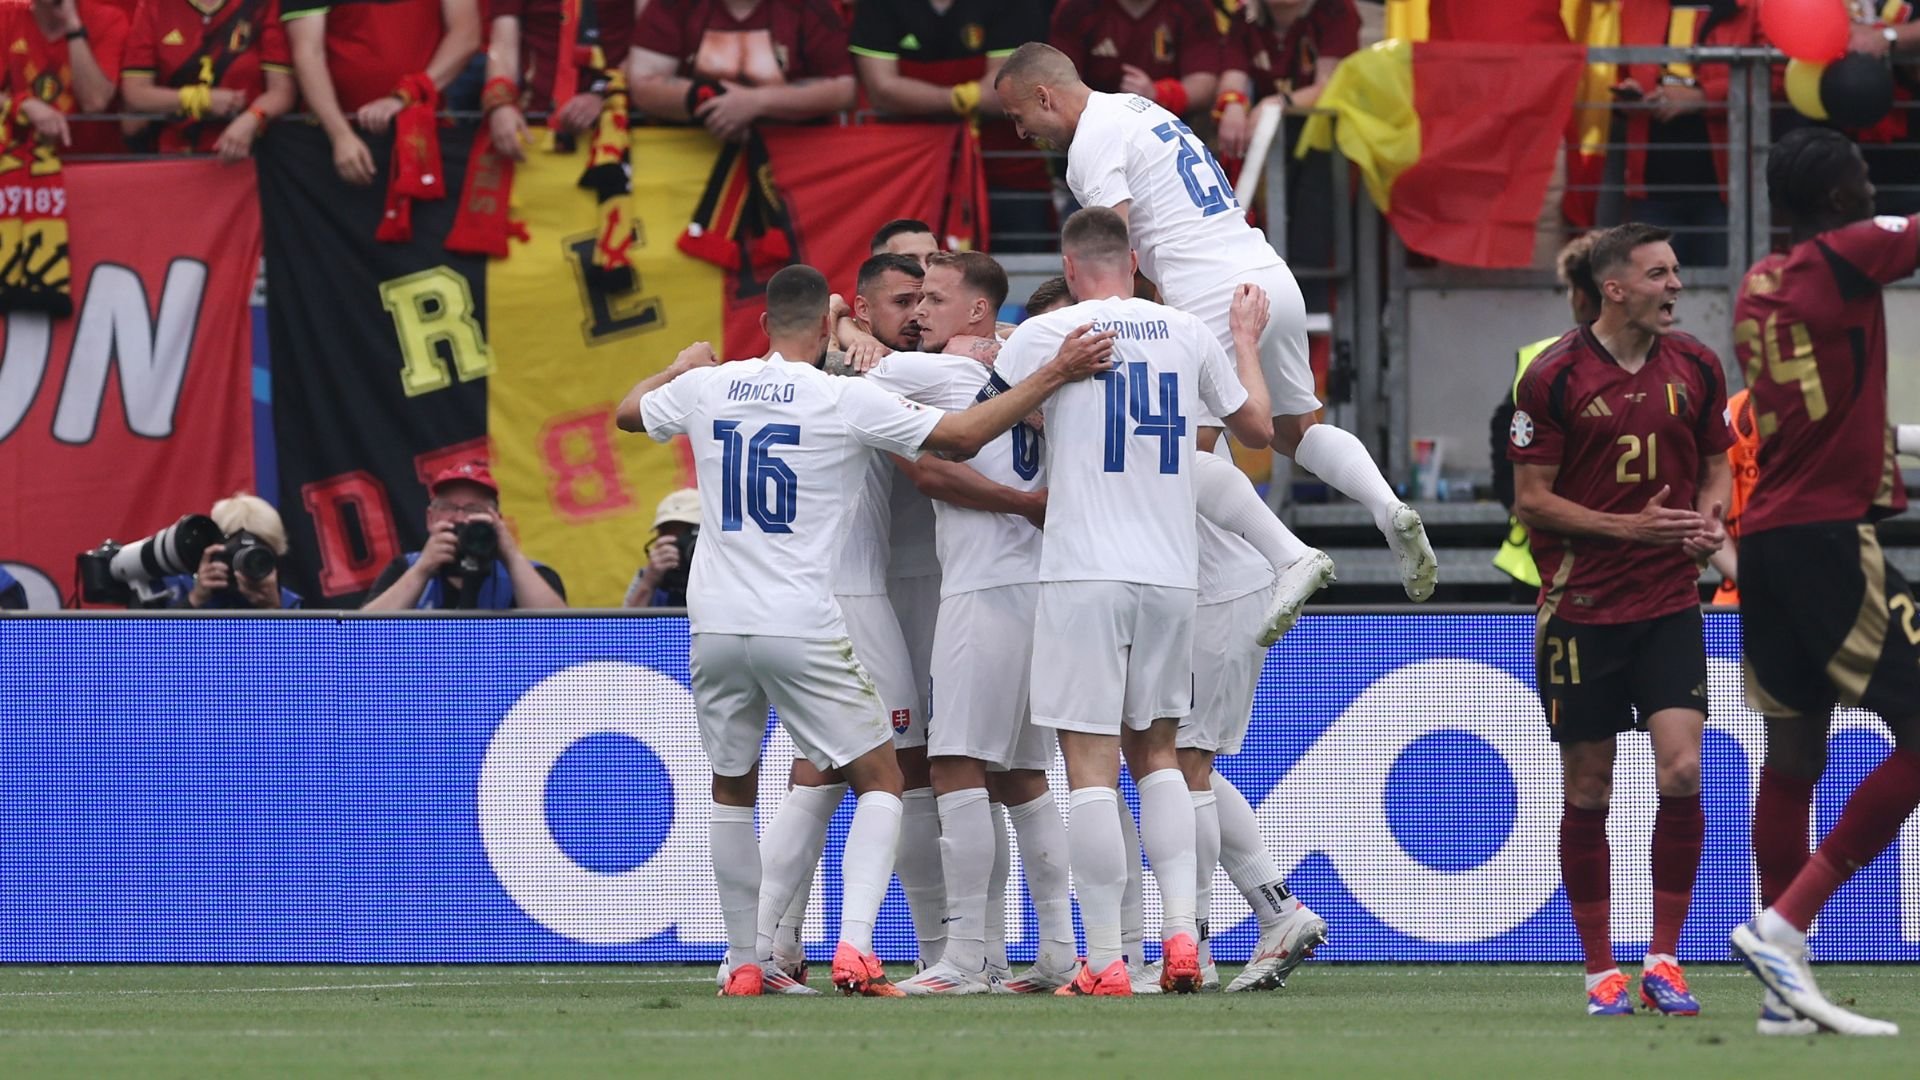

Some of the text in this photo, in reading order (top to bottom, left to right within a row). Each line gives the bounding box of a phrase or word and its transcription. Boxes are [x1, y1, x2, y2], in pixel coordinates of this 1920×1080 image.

[727, 379, 795, 404] HANCKO
[1093, 361, 1186, 475] 14
[713, 419, 801, 534] 16
[1615, 432, 1657, 484] 21
[1546, 636, 1581, 685] 21
